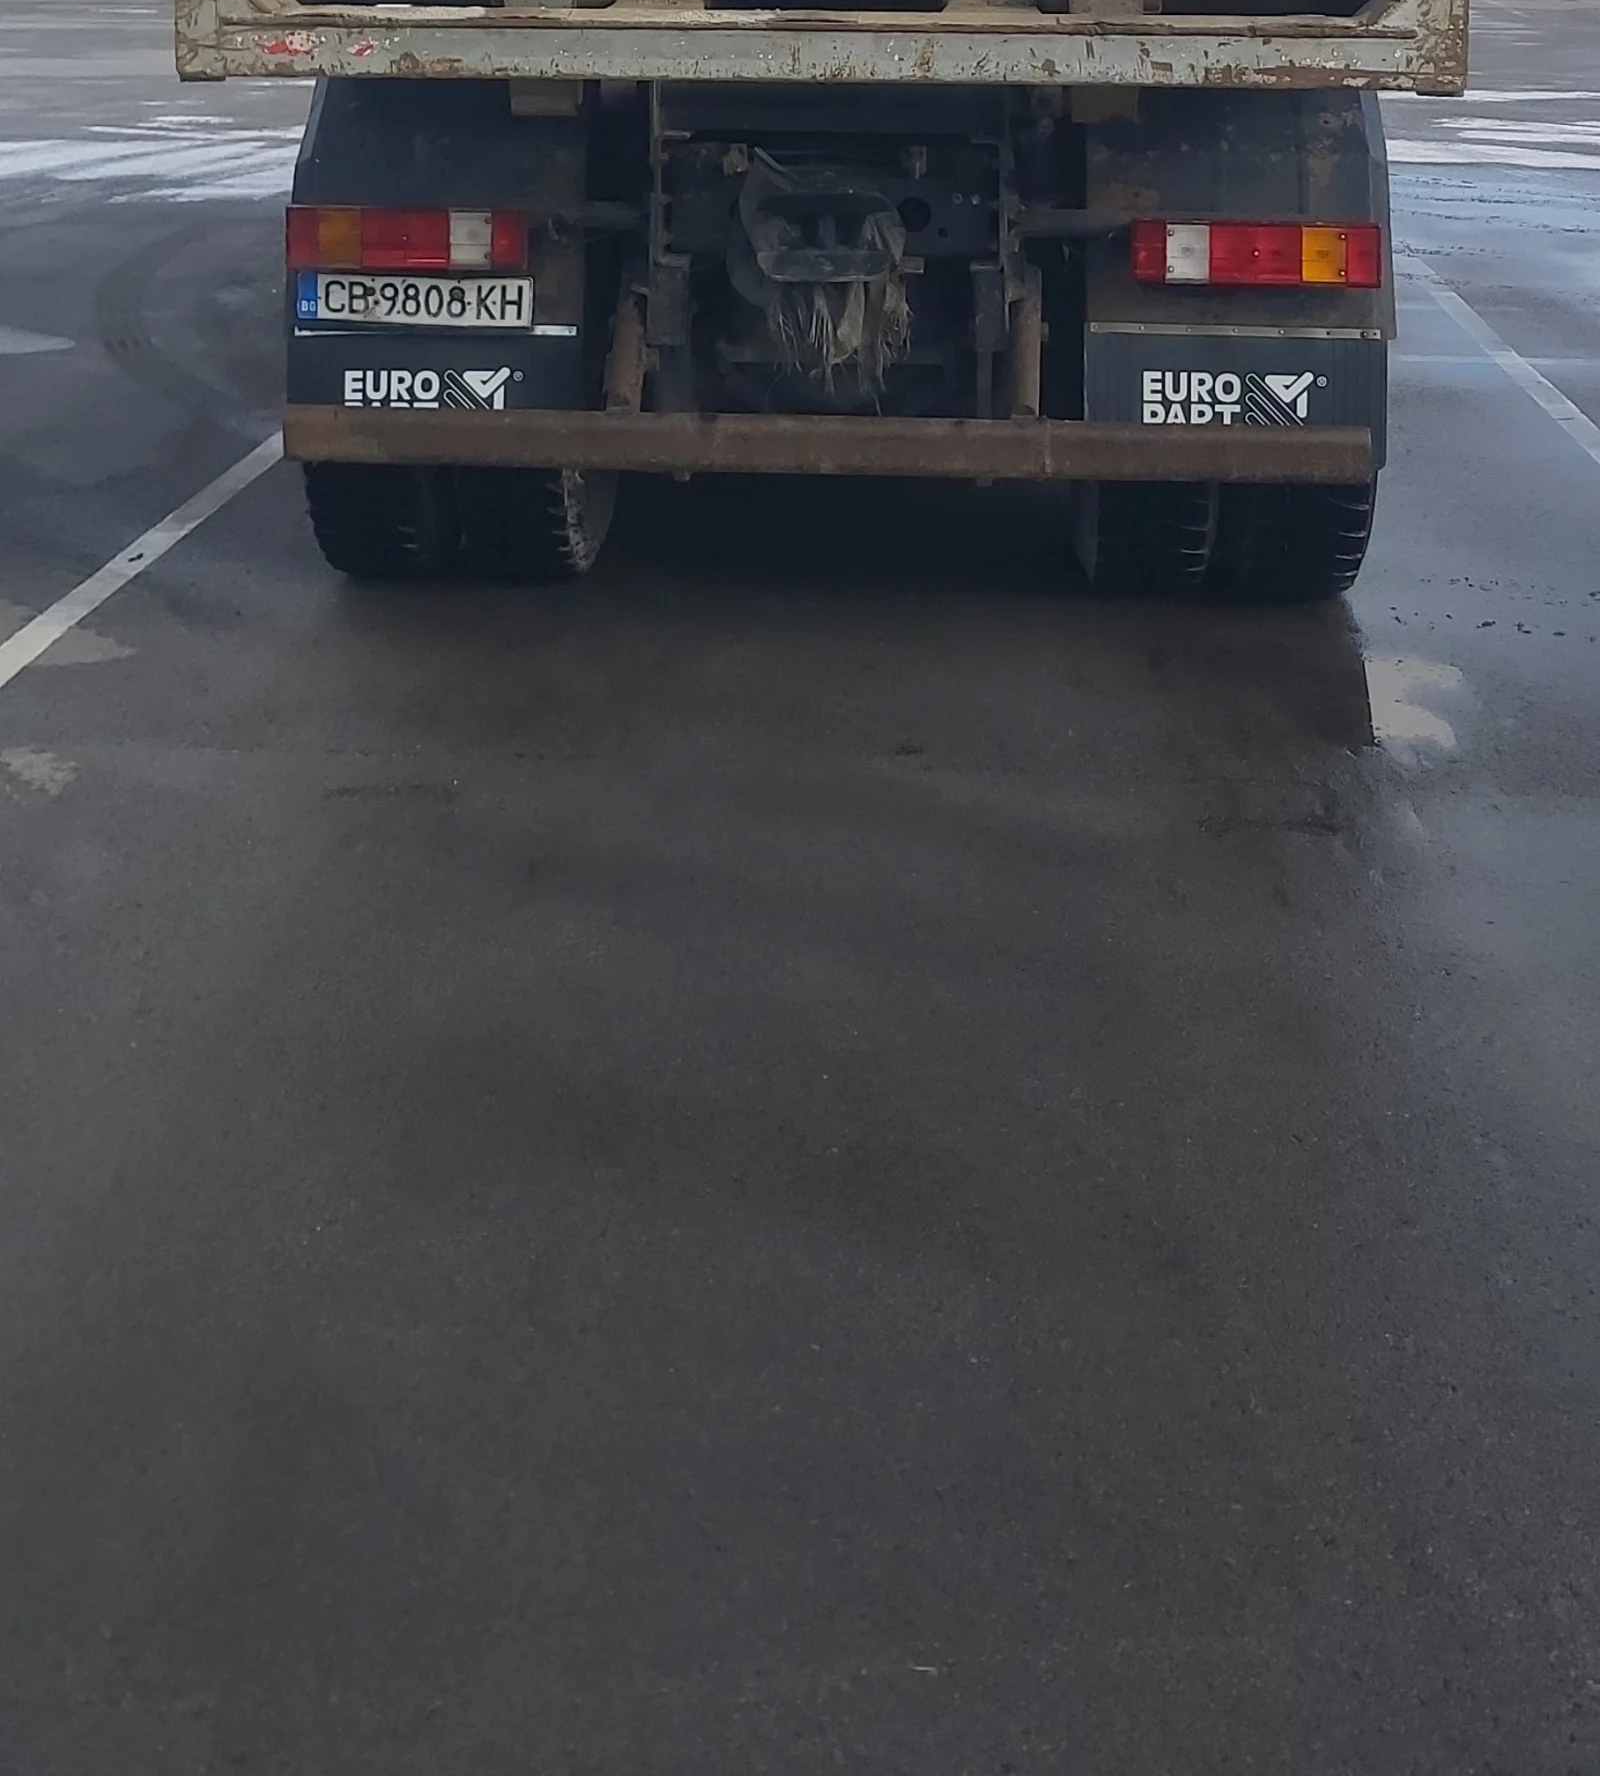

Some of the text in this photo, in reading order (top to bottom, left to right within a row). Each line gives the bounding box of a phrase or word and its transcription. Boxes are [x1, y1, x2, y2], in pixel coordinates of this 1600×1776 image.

[301, 300, 316, 313] BG
[344, 369, 441, 401] EURO
[1142, 370, 1242, 403] EURO
